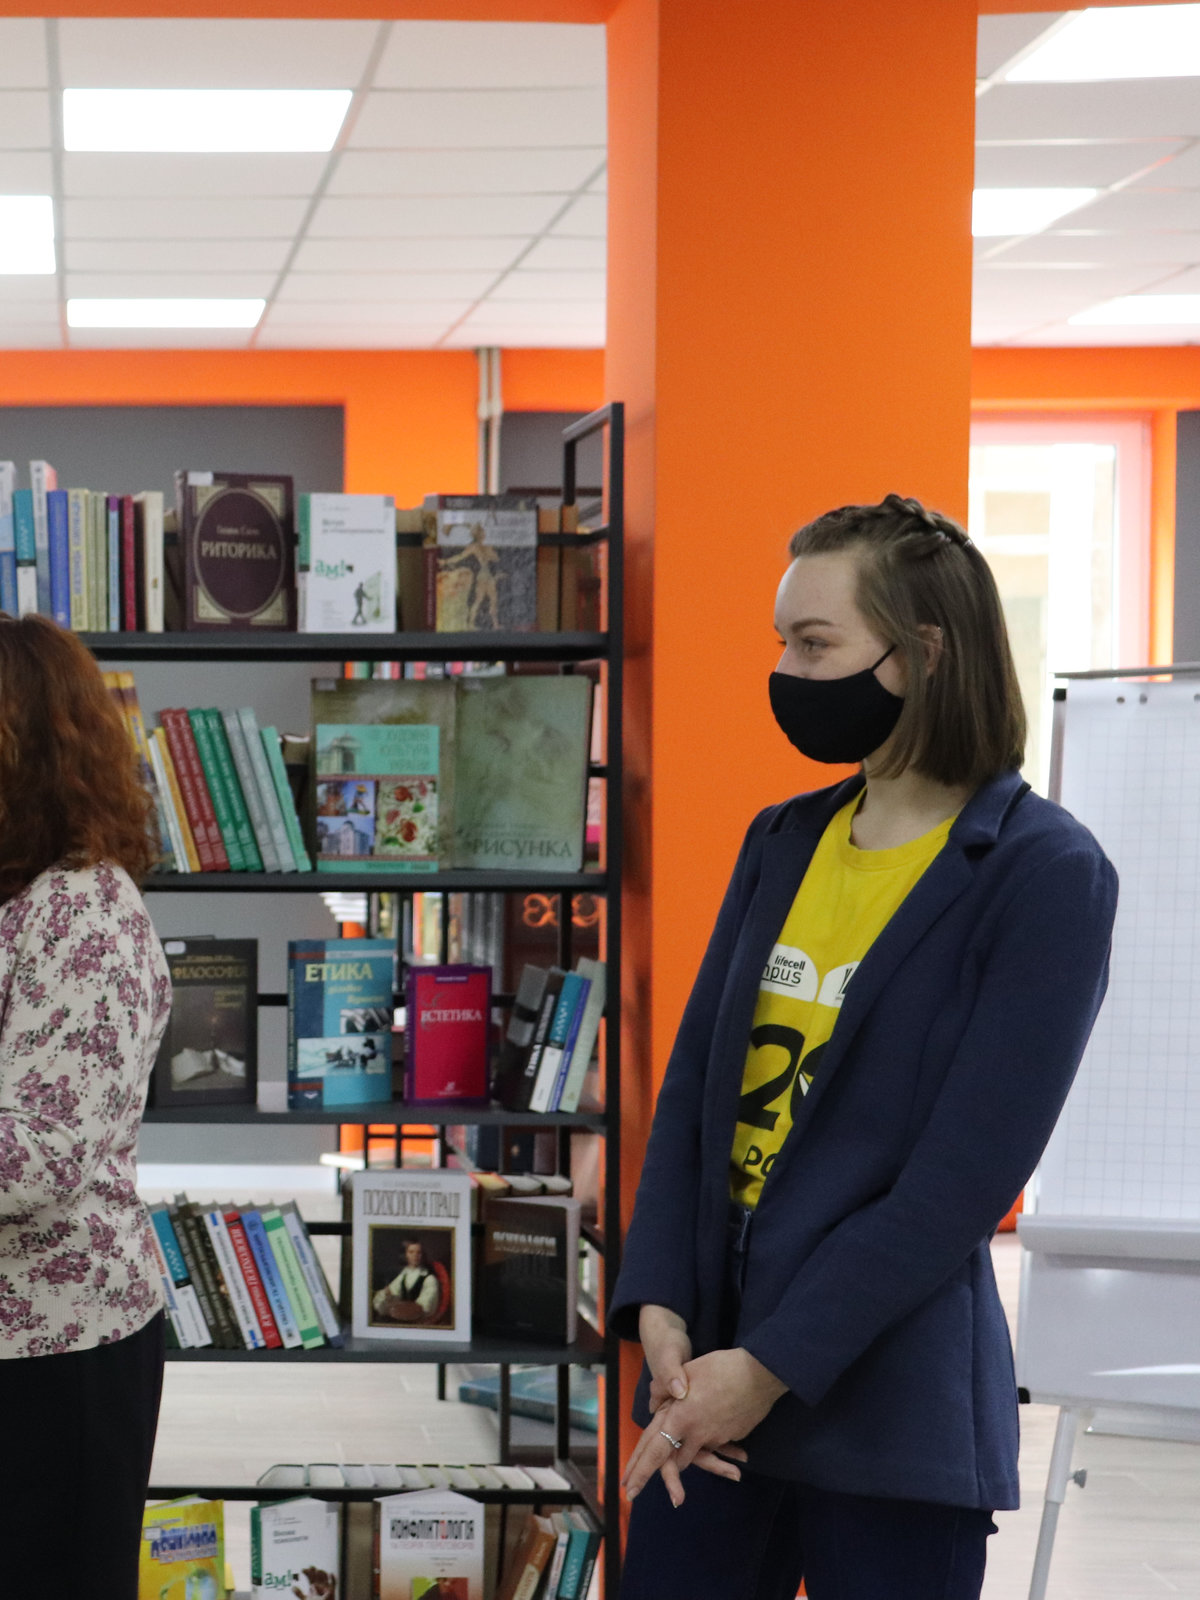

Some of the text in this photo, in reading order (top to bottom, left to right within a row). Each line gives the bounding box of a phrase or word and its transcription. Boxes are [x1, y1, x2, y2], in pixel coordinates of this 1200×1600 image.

[201, 541, 277, 560] РИТОРИКА
[472, 838, 572, 858] РИСУНКА
[774, 954, 806, 971] lifecell
[304, 963, 373, 982] ЕТИКА
[420, 1009, 482, 1023] ЕСТЕТИКА
[390, 1519, 475, 1540] КОНФЛІКТОЛОГІЯ
[264, 1570, 292, 1589] ам!
